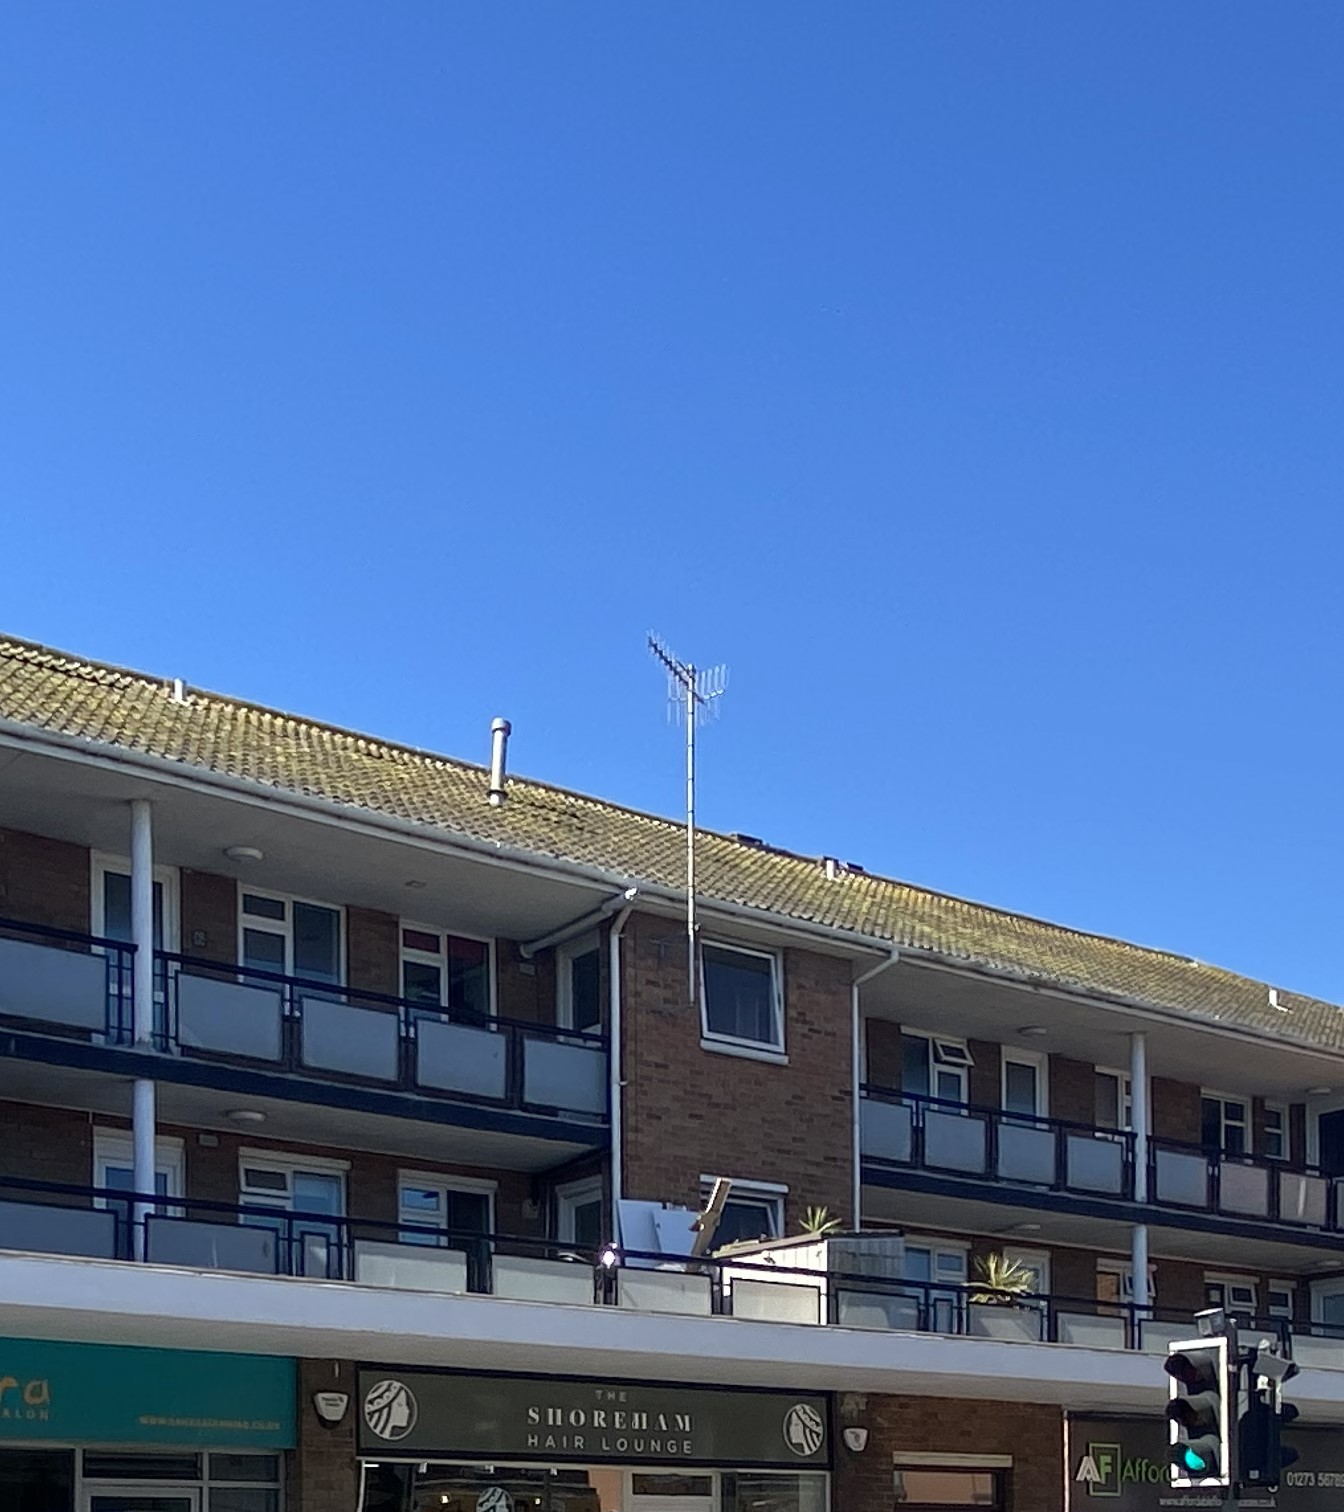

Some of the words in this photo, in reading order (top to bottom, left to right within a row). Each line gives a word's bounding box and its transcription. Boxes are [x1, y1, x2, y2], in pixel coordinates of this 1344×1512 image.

[595, 1390, 628, 1403] THE
[527, 1406, 693, 1433] SHOREHAM
[527, 1433, 585, 1450] HAIR
[602, 1436, 694, 1455] LOUNGE
